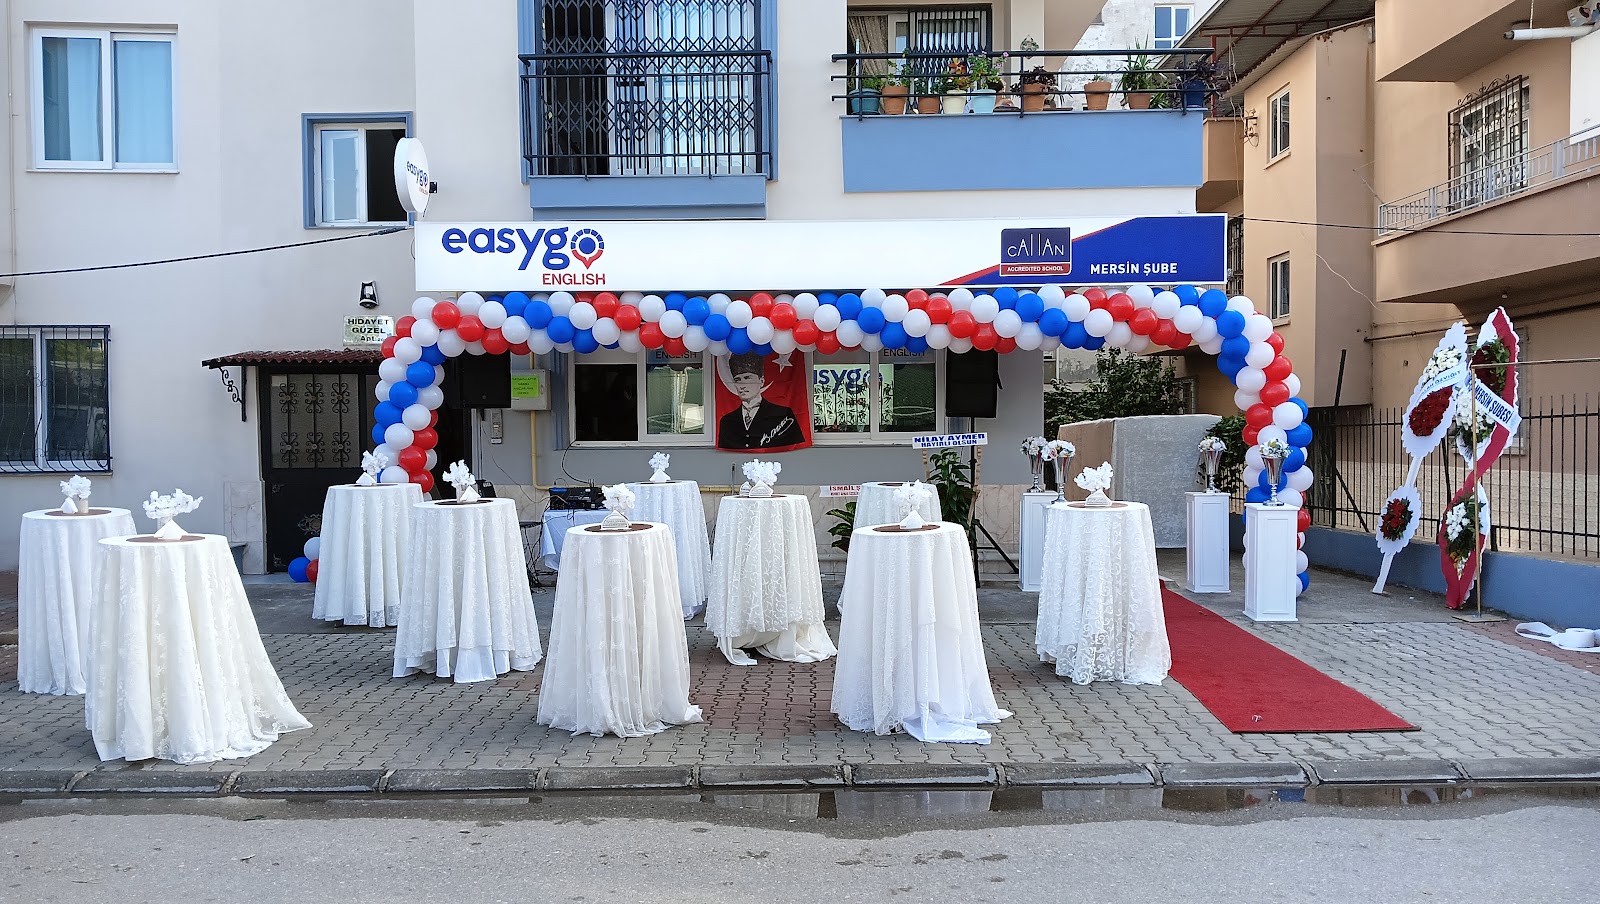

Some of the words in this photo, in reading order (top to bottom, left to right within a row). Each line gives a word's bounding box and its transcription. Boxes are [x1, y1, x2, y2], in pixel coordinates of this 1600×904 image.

[406, 160, 428, 187] easygo
[441, 226, 605, 270] easygo
[1090, 261, 1139, 275] MERSİN
[1143, 263, 1178, 276] ŞUBE
[542, 273, 606, 285] ENGLISH
[1489, 400, 1515, 424] ŞUBESİ
[947, 433, 985, 441] AYMER
